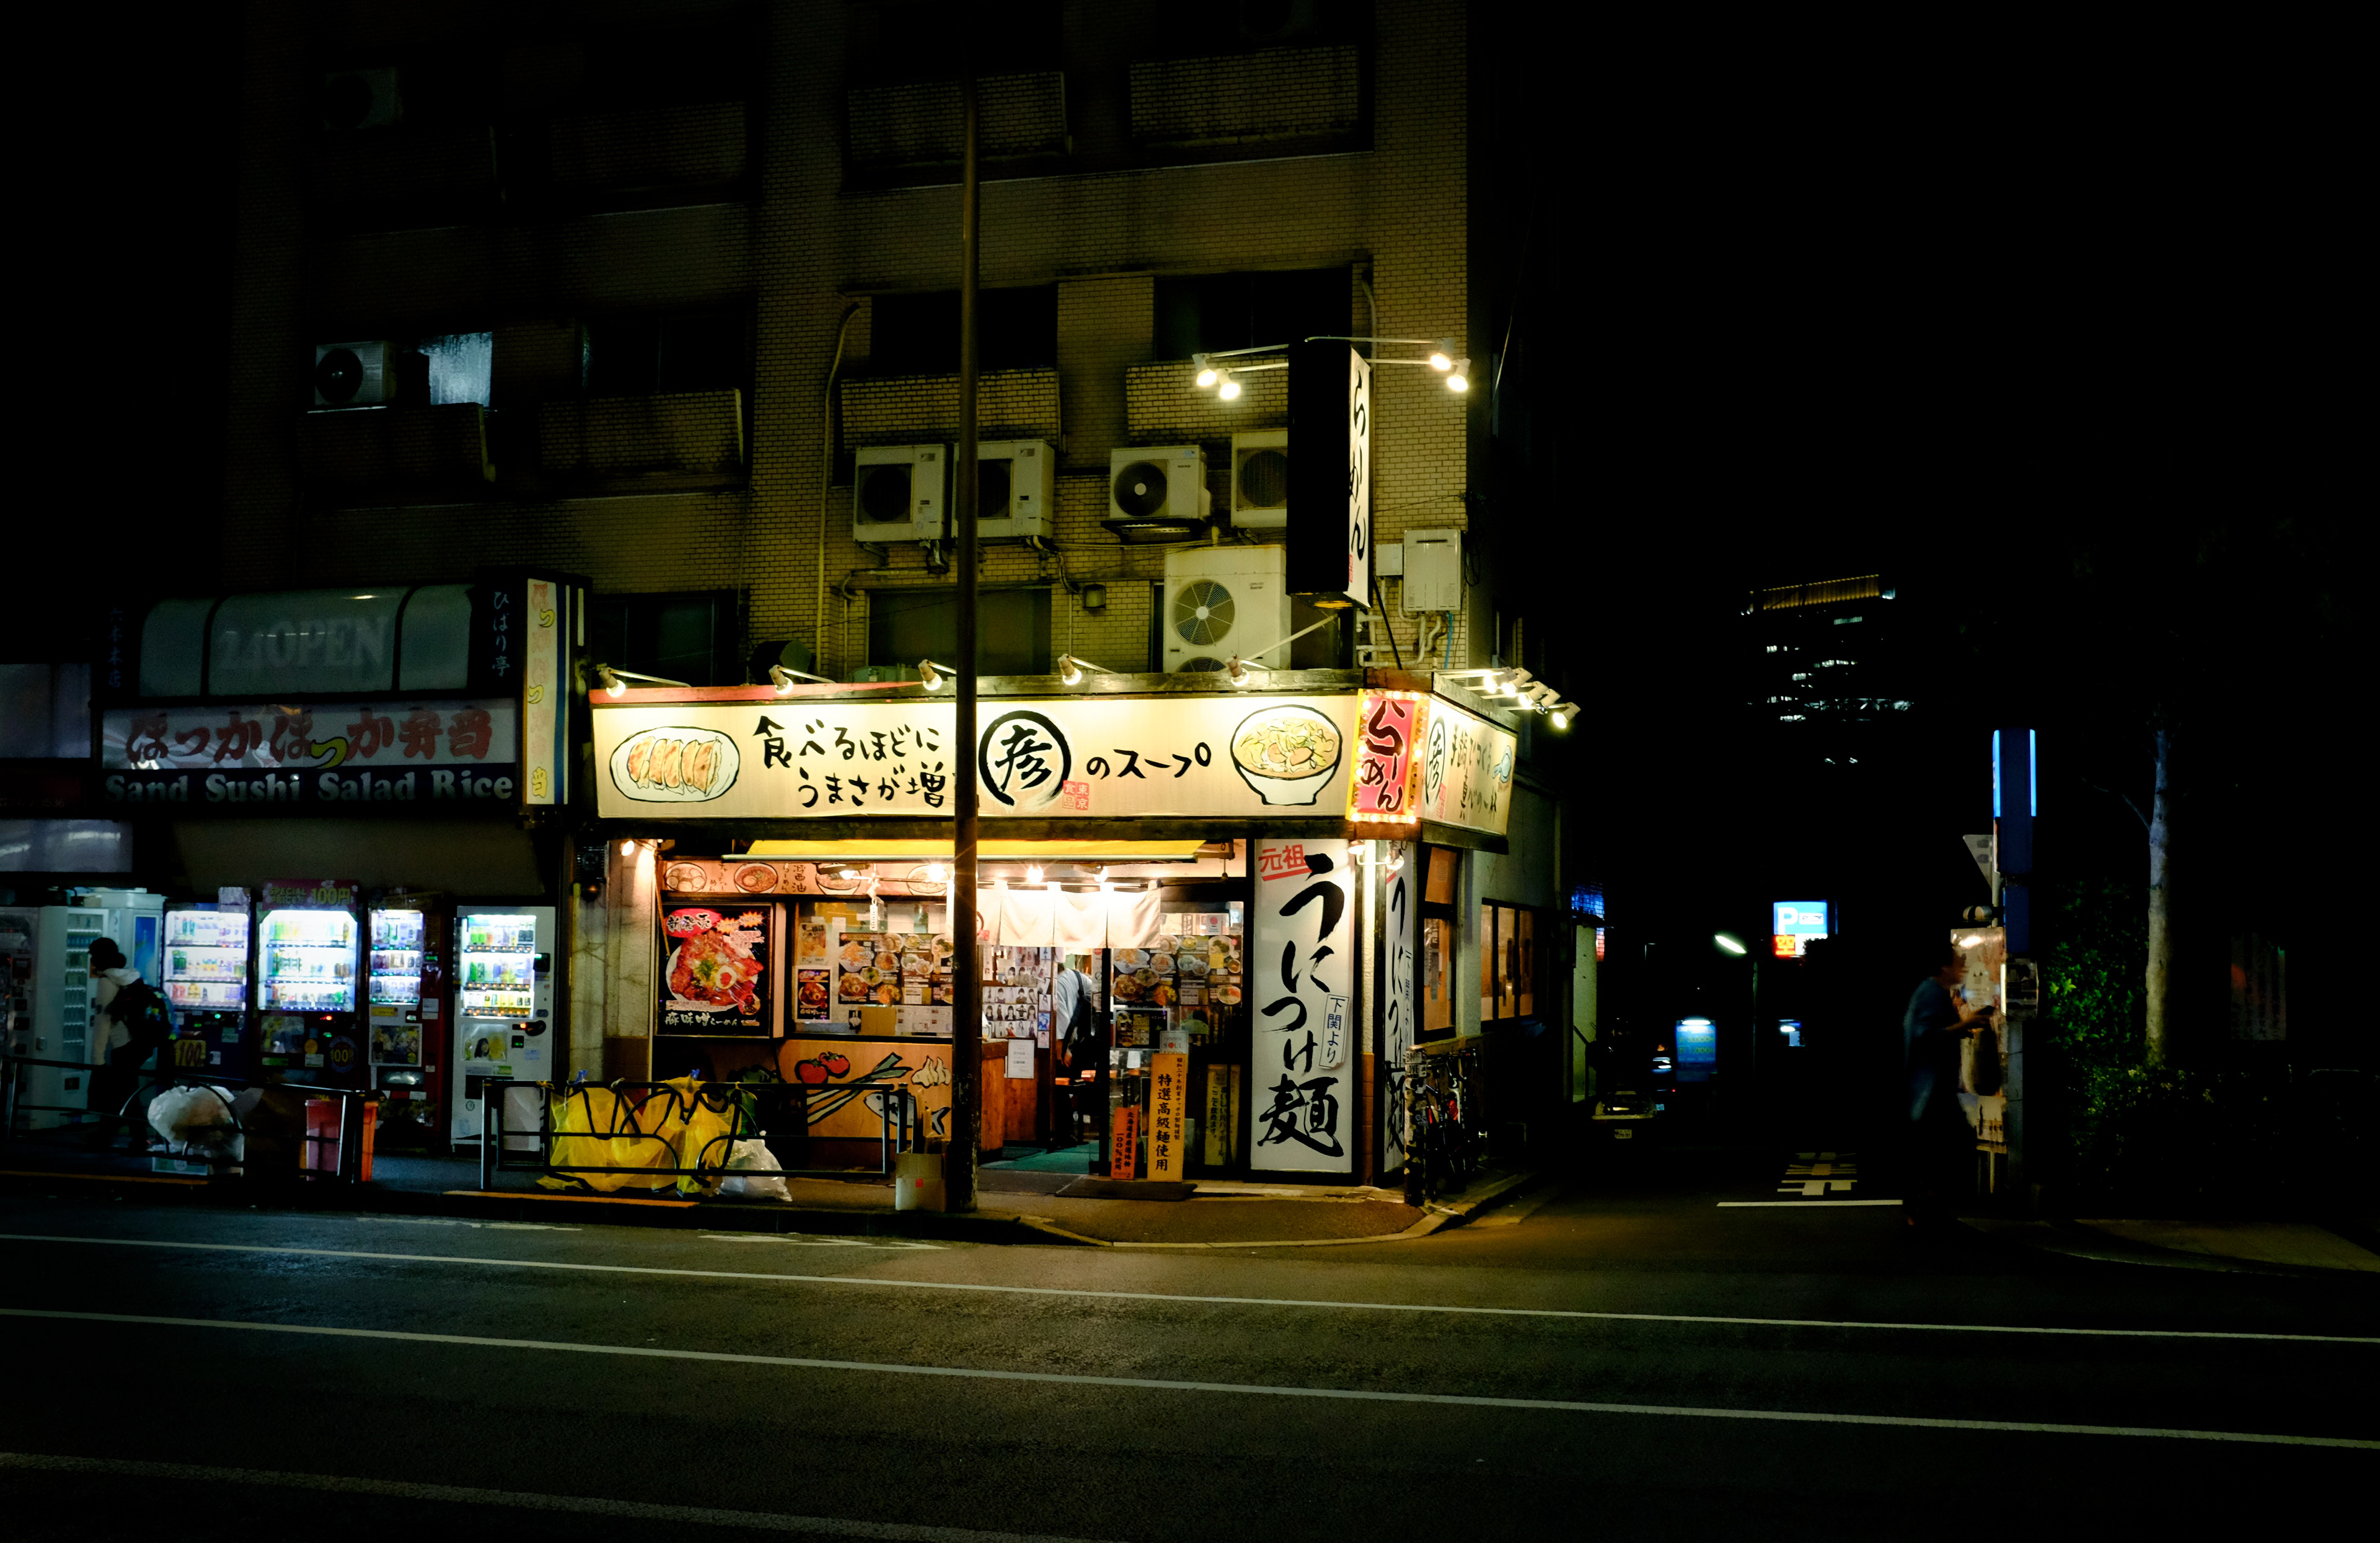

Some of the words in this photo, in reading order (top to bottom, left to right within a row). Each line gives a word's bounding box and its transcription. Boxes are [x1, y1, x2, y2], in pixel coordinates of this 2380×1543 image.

[1349, 370, 1365, 562] らーめん
[492, 591, 510, 677] ひばり亭
[753, 715, 940, 769] 食べるほどに
[1086, 741, 1212, 780] のスープ
[1360, 700, 1406, 812] らーめん
[105, 775, 189, 803] Sand
[205, 774, 301, 802] Sushi
[317, 771, 416, 802] Salad
[431, 769, 513, 800] Rice
[798, 761, 955, 808] うまさが増
[1258, 844, 1308, 873] 元祖
[667, 913, 712, 932] 新発売
[1778, 907, 1798, 935] P
[1257, 852, 1345, 1157] うにつけ麺
[1325, 997, 1346, 1063] 下関より
[1155, 1073, 1173, 1172] 特選高級麺使用
